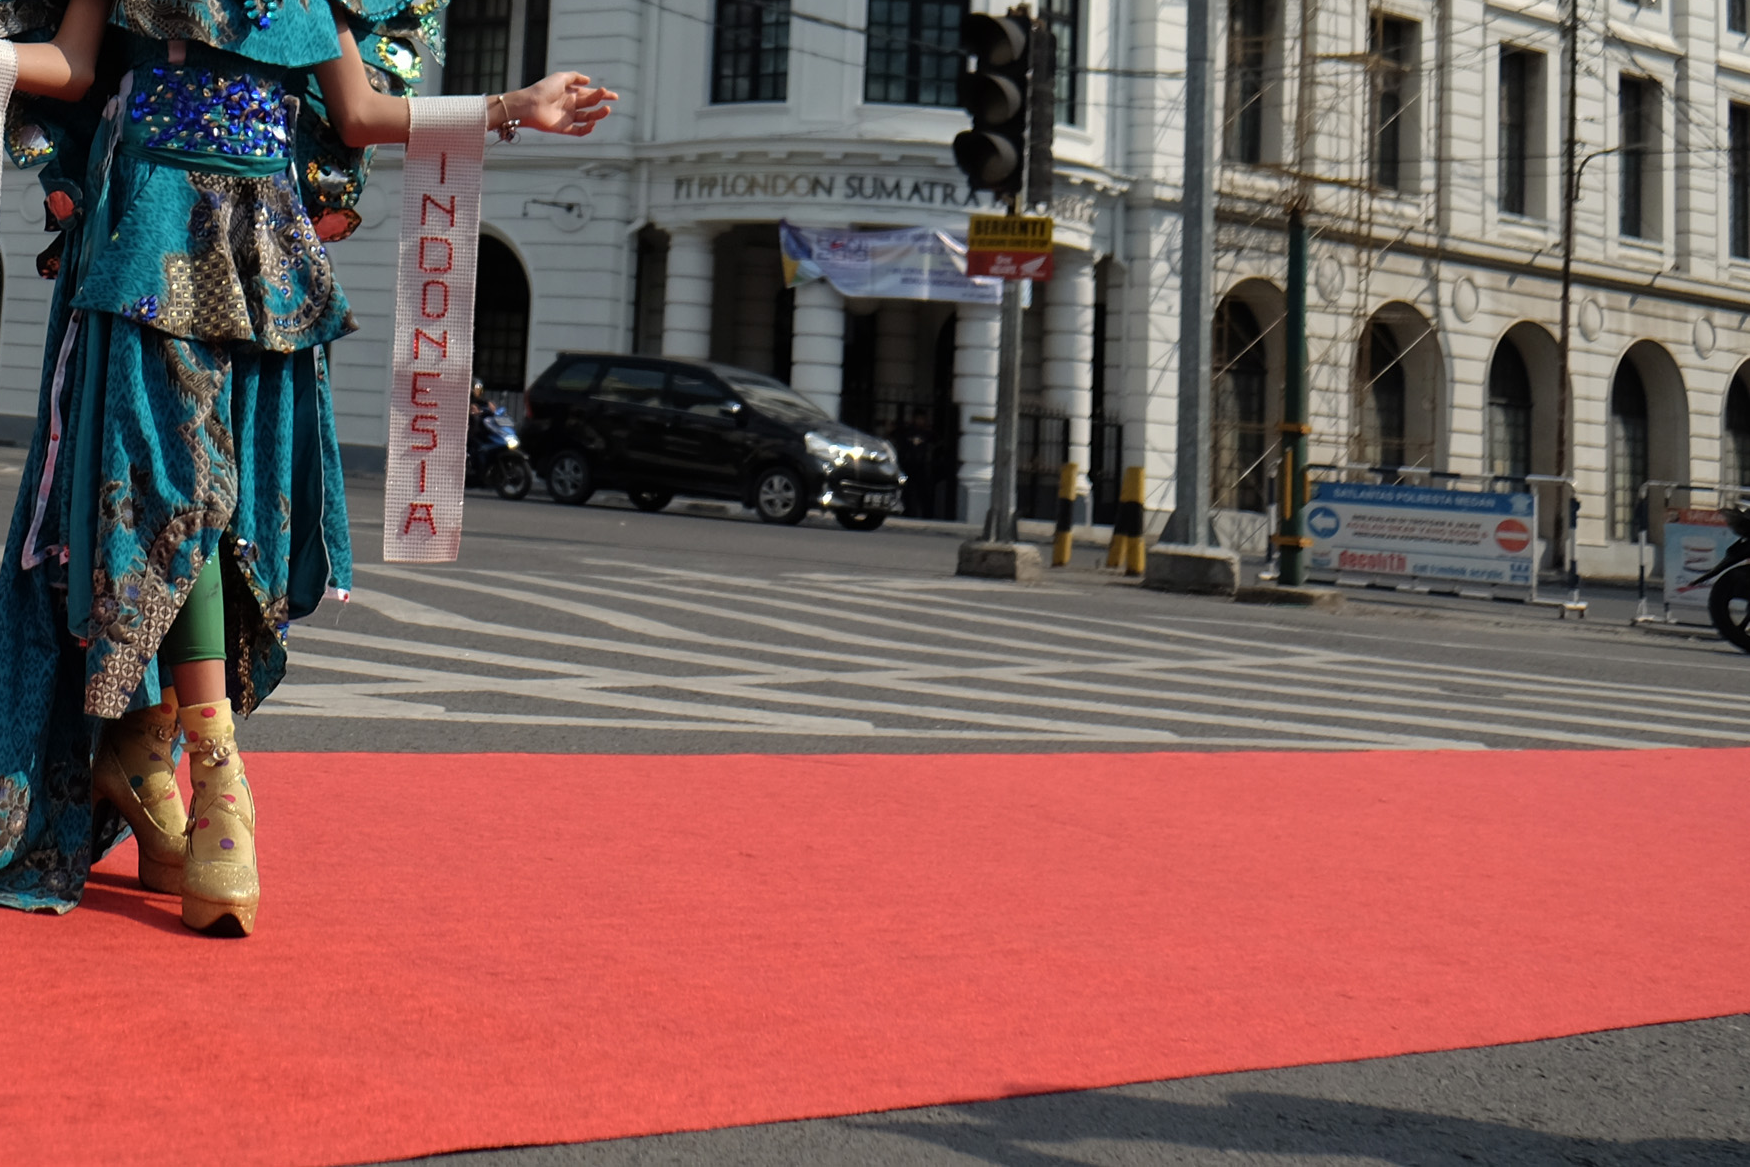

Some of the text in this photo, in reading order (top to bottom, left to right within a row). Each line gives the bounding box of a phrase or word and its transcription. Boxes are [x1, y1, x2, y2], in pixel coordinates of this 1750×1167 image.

[720, 174, 836, 198] LONDON
[844, 175, 982, 207] SUMATRA
[974, 220, 1046, 237] BERHENTI
[403, 151, 456, 535] INDONESIA
[1332, 487, 1496, 508] SATLANTAS POLRESTA MEDAN
[1338, 549, 1407, 572] decolith
